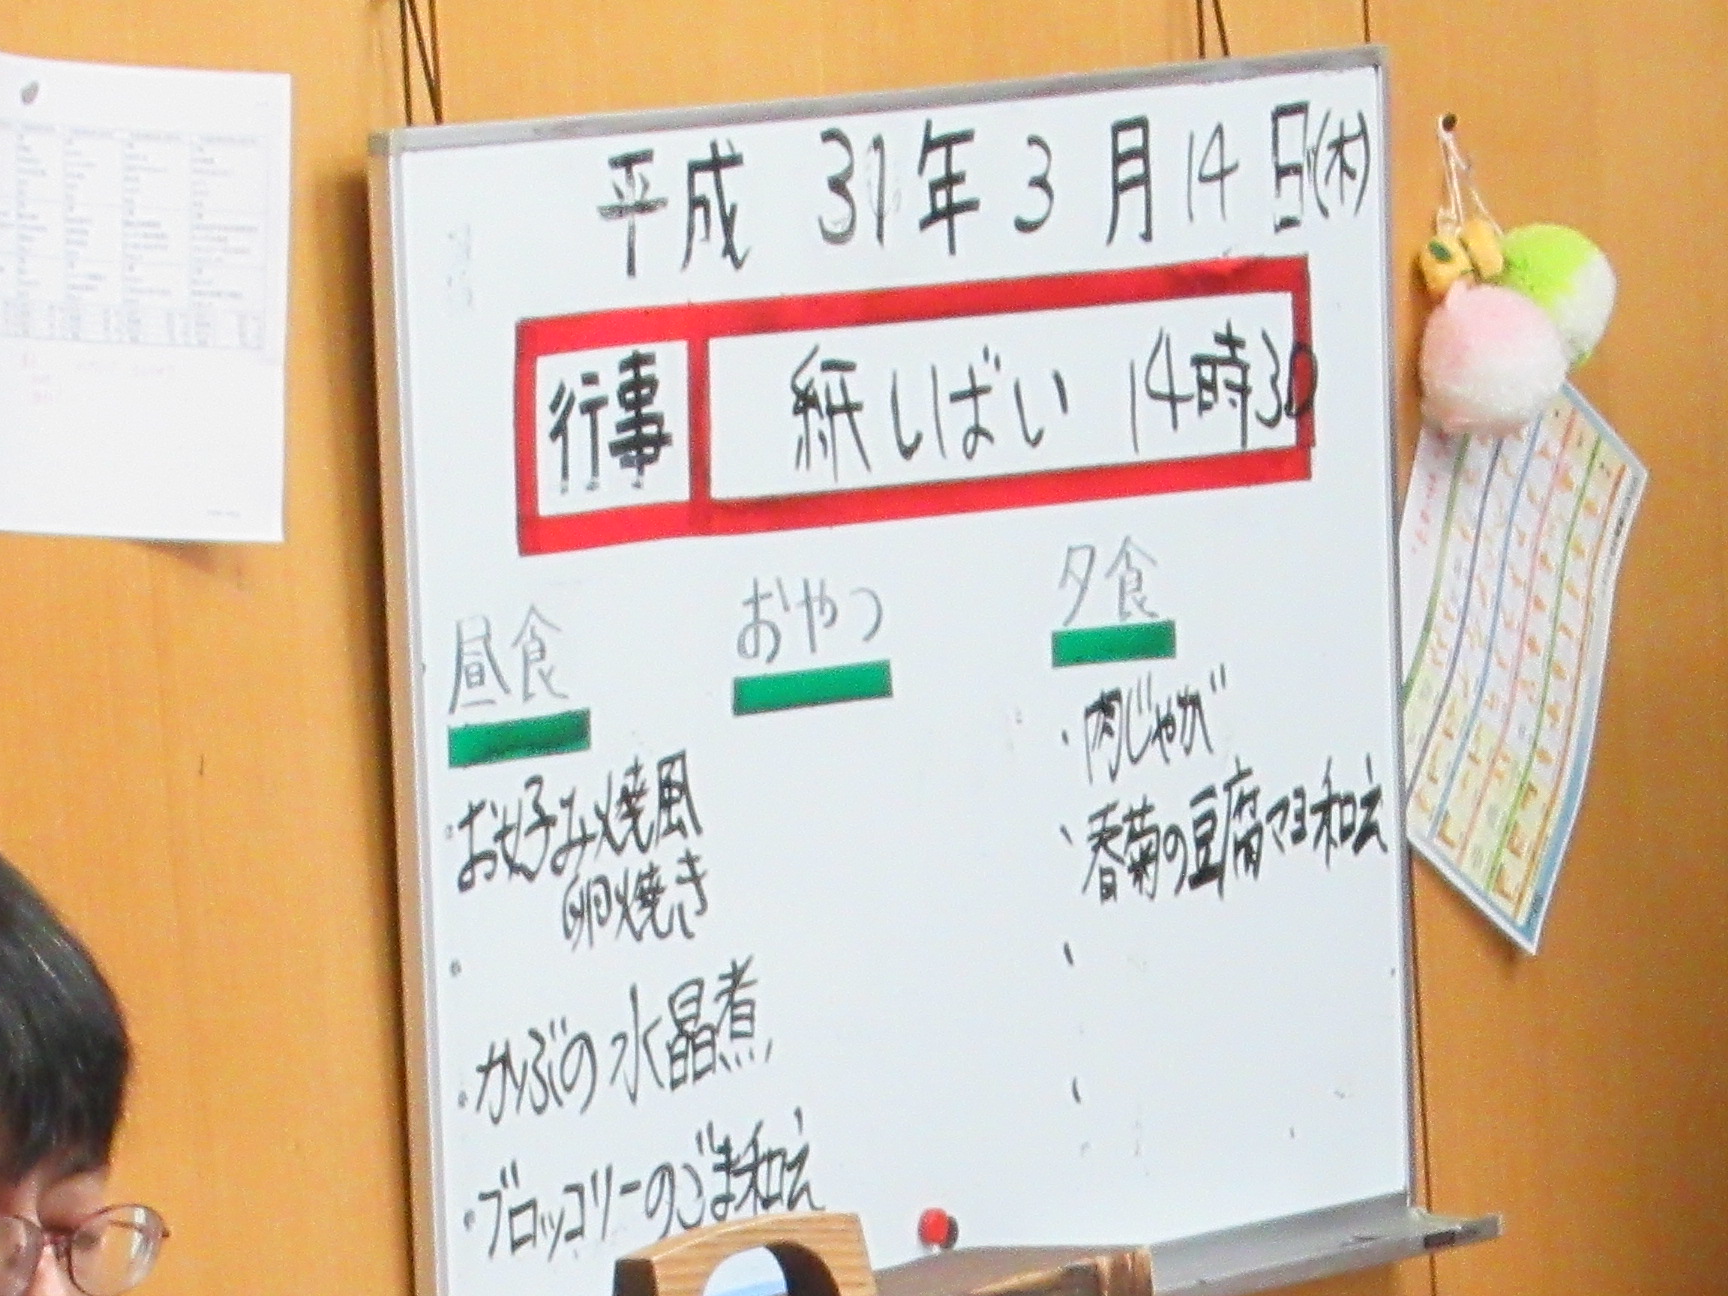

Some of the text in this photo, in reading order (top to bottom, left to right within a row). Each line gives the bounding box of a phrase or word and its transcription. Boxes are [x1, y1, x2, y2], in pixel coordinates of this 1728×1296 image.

[548, 349, 672, 493] 行事
[791, 344, 1070, 482] 紙しばい
[449, 535, 1159, 714] 昼食 おやつ 夕食
[1083, 662, 1226, 784] 肉じゃが
[561, 848, 708, 952] 卵焼き
